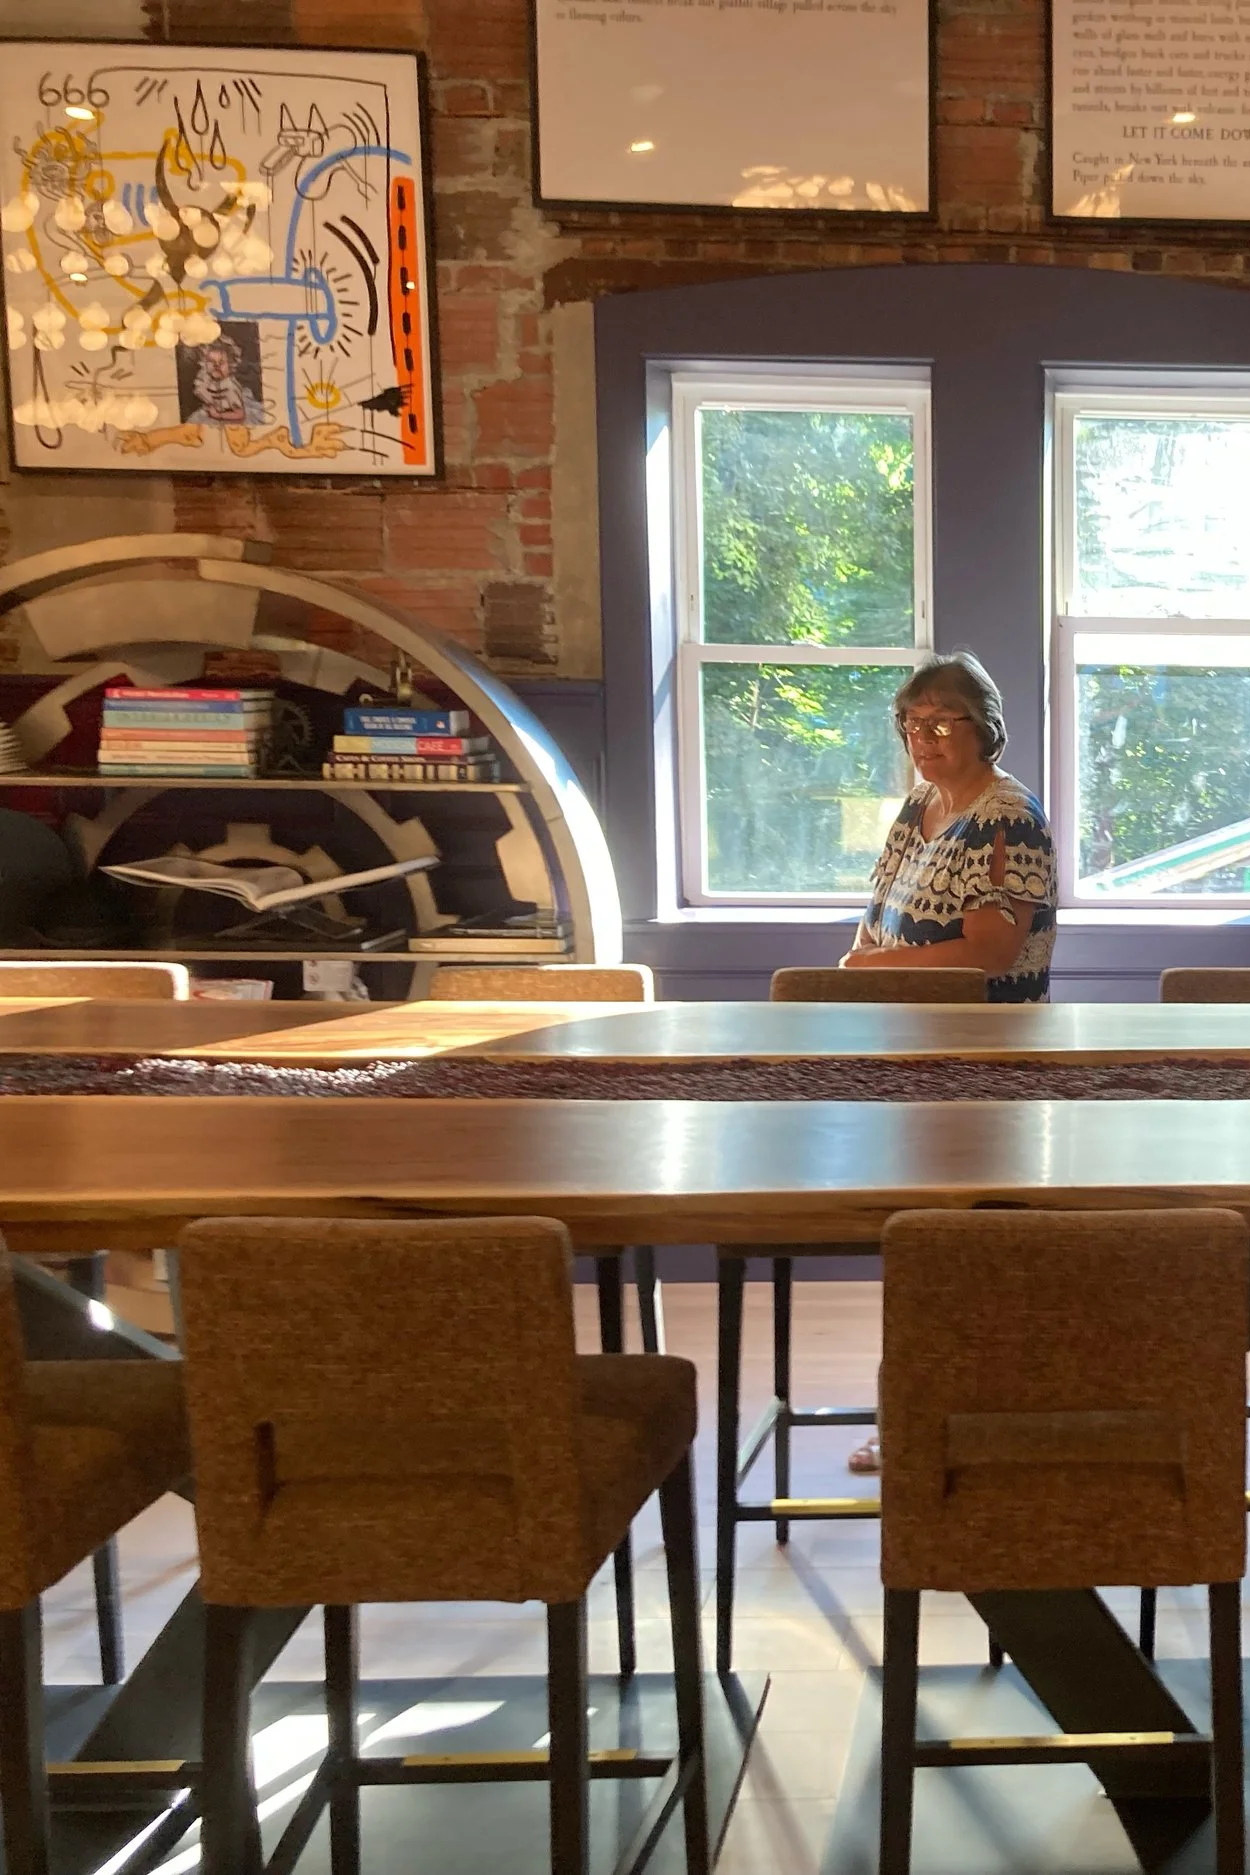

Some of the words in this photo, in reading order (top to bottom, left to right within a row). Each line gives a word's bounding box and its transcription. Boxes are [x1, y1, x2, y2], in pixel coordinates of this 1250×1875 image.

[1170, 30, 1188, 41] and
[1193, 50, 1210, 61] and
[1156, 66, 1173, 78] and
[38, 71, 110, 107] 666
[1072, 83, 1090, 94] and
[1187, 85, 1197, 96] of
[1222, 86, 1239, 97] and
[1122, 126, 1149, 139] LET
[1153, 126, 1166, 140] IT
[1170, 127, 1214, 141] COME
[1072, 152, 1110, 168] Caught
[1128, 152, 1152, 165] New
[1154, 152, 1178, 166] York
[1222, 155, 1238, 167] the
[1138, 171, 1165, 184] down
[1169, 171, 1184, 184] the
